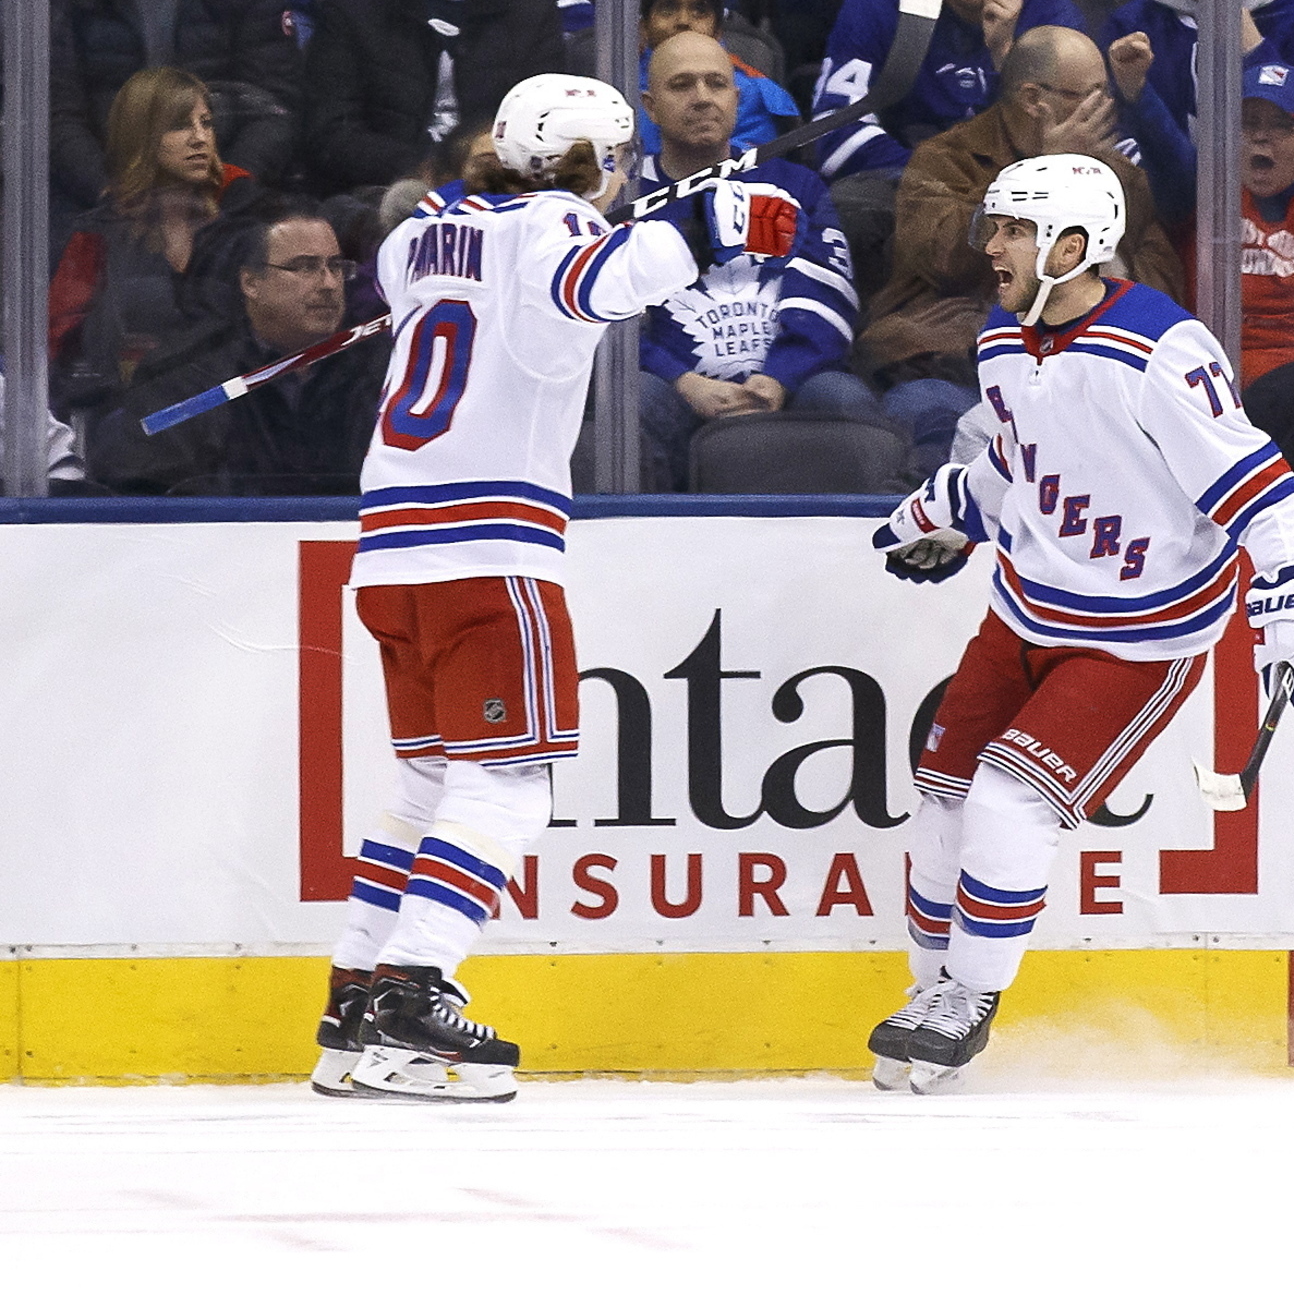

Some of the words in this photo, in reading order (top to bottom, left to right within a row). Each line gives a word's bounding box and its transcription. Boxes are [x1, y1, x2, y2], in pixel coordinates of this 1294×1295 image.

[631, 148, 759, 219] CCM
[711, 319, 772, 342] MAPLE
[1184, 361, 1243, 419] 77
[1002, 727, 1078, 784] BAUER
[490, 849, 1124, 916] NSURAE
